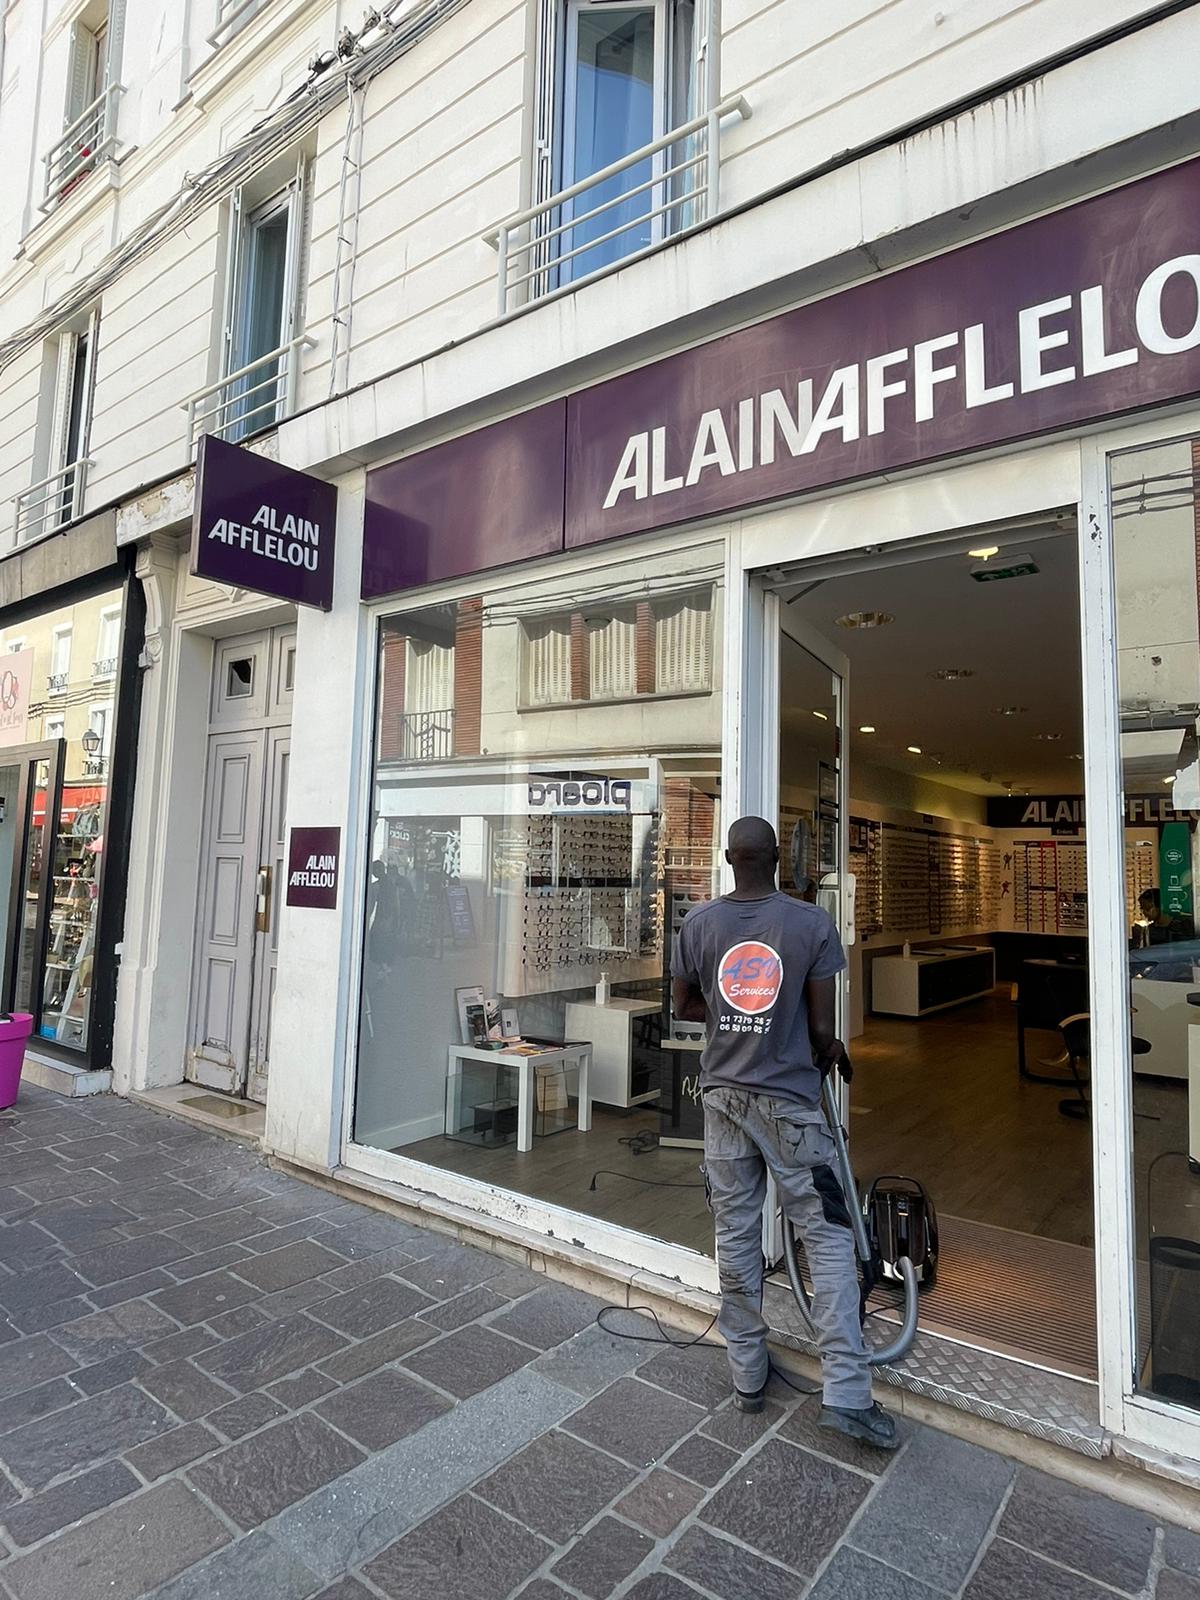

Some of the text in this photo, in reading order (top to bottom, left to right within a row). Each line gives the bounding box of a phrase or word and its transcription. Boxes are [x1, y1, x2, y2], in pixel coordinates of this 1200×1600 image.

[251, 504, 320, 546] ALAIN
[207, 518, 319, 571] AFFLELOU
[305, 854, 336, 870] ALAIN
[289, 871, 335, 888] AFFLELOU
[728, 983, 776, 997] Services
[719, 1023, 731, 1031] 06
[720, 1015, 731, 1023] 01
